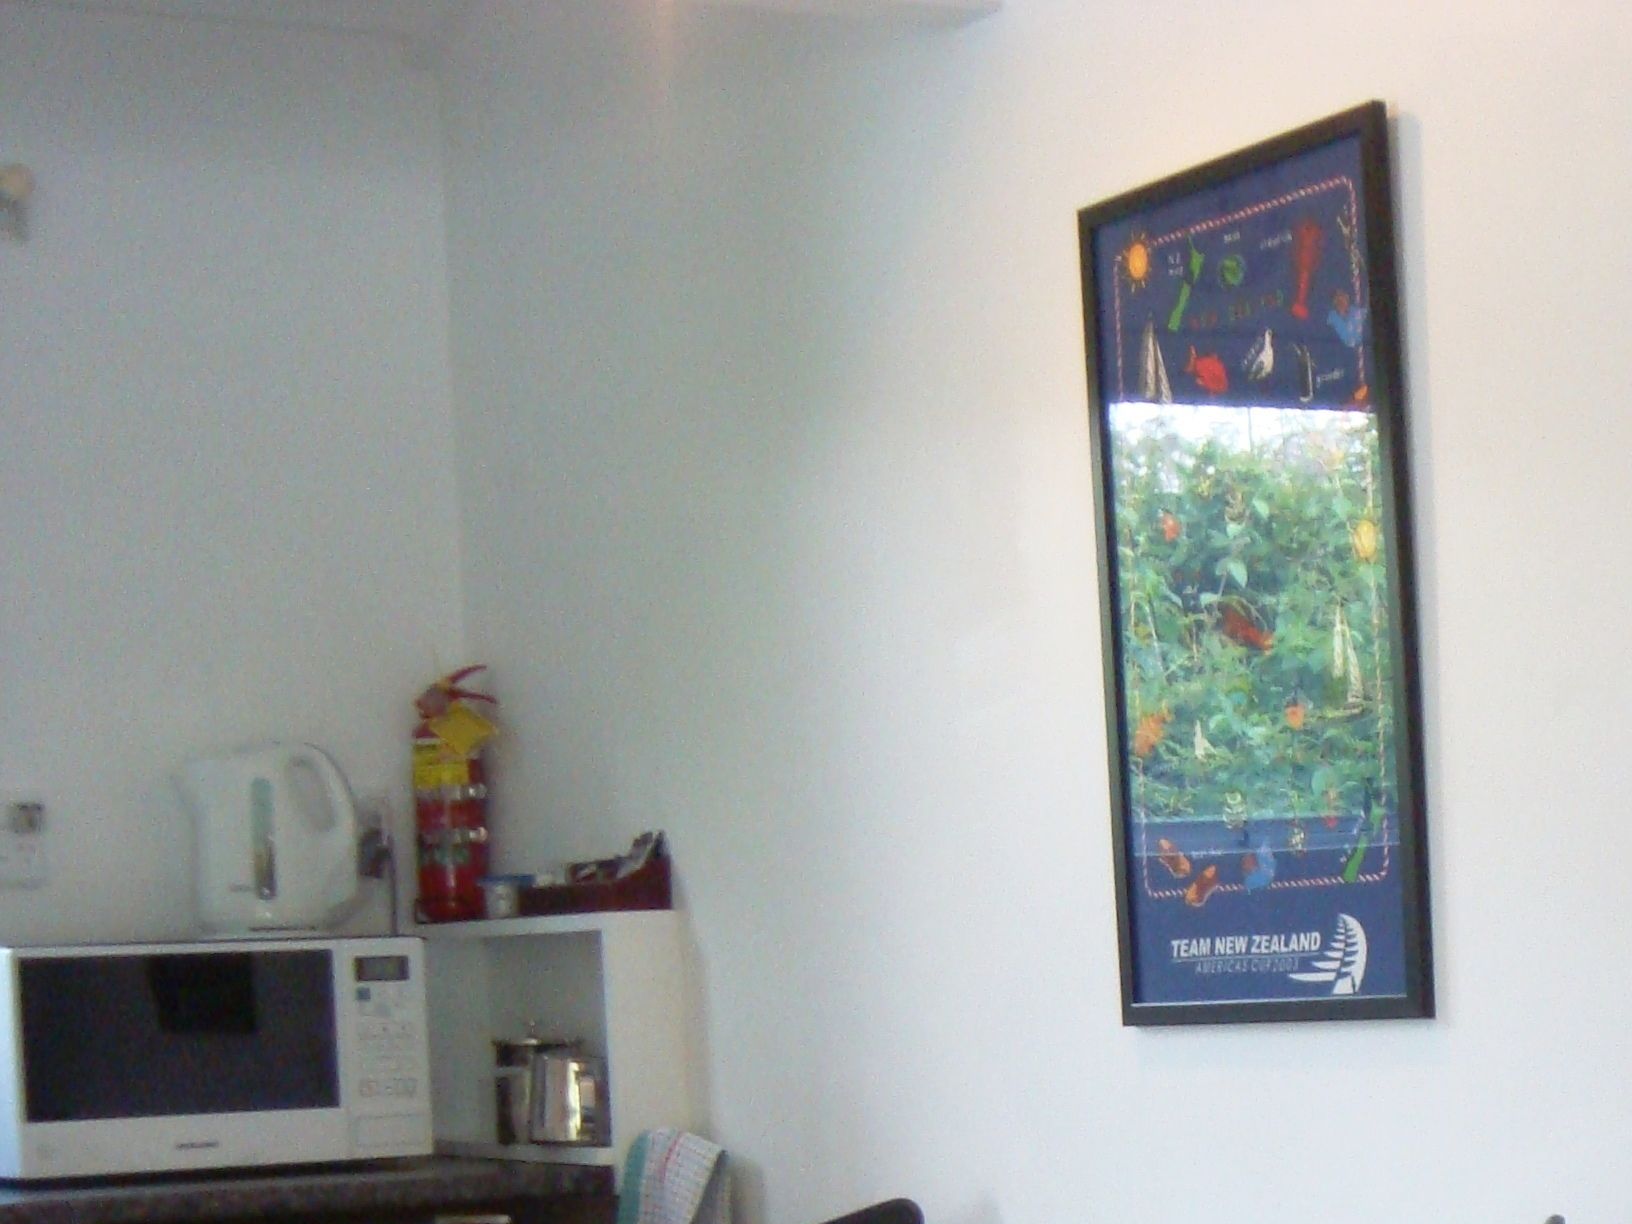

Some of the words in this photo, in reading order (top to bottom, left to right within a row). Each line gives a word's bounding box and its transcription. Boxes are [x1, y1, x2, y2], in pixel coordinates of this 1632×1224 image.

[1171, 937, 1211, 957] TEAM
[1215, 935, 1248, 955] NEW
[1251, 931, 1321, 953] ZEALAND
